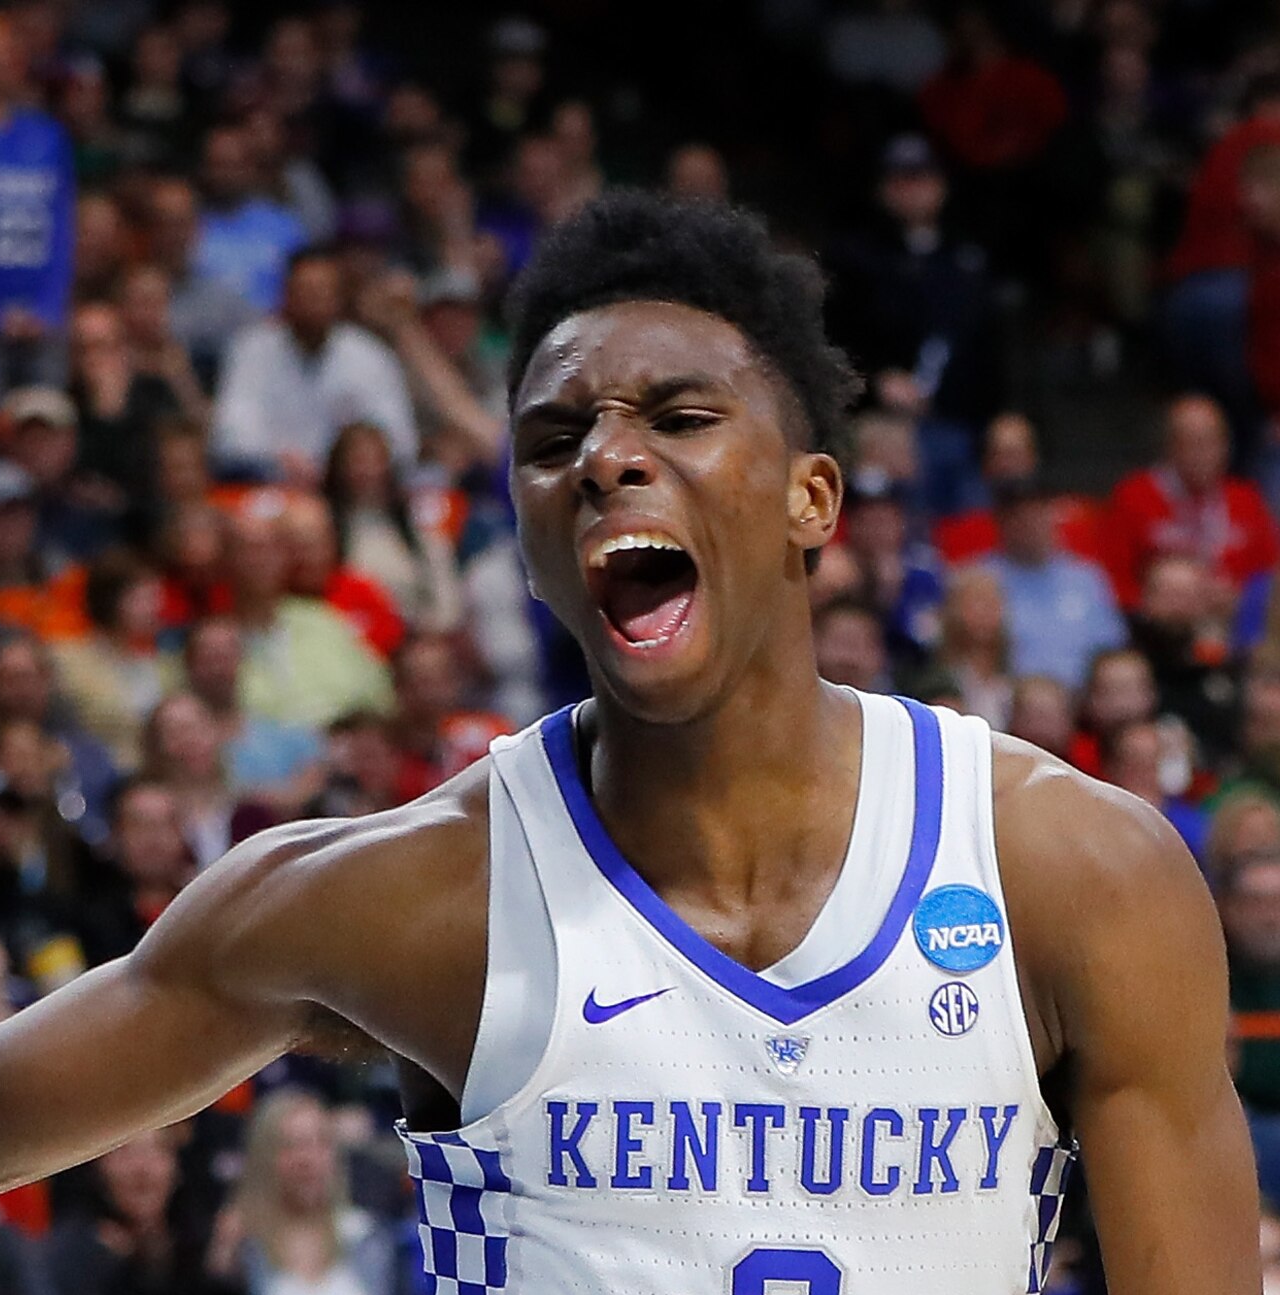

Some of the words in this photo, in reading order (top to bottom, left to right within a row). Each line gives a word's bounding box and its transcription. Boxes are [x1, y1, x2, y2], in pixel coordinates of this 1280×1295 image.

[928, 922, 1002, 951] NCAA
[930, 982, 979, 1036] SEC
[544, 1099, 1020, 1198] KENTUCKY
